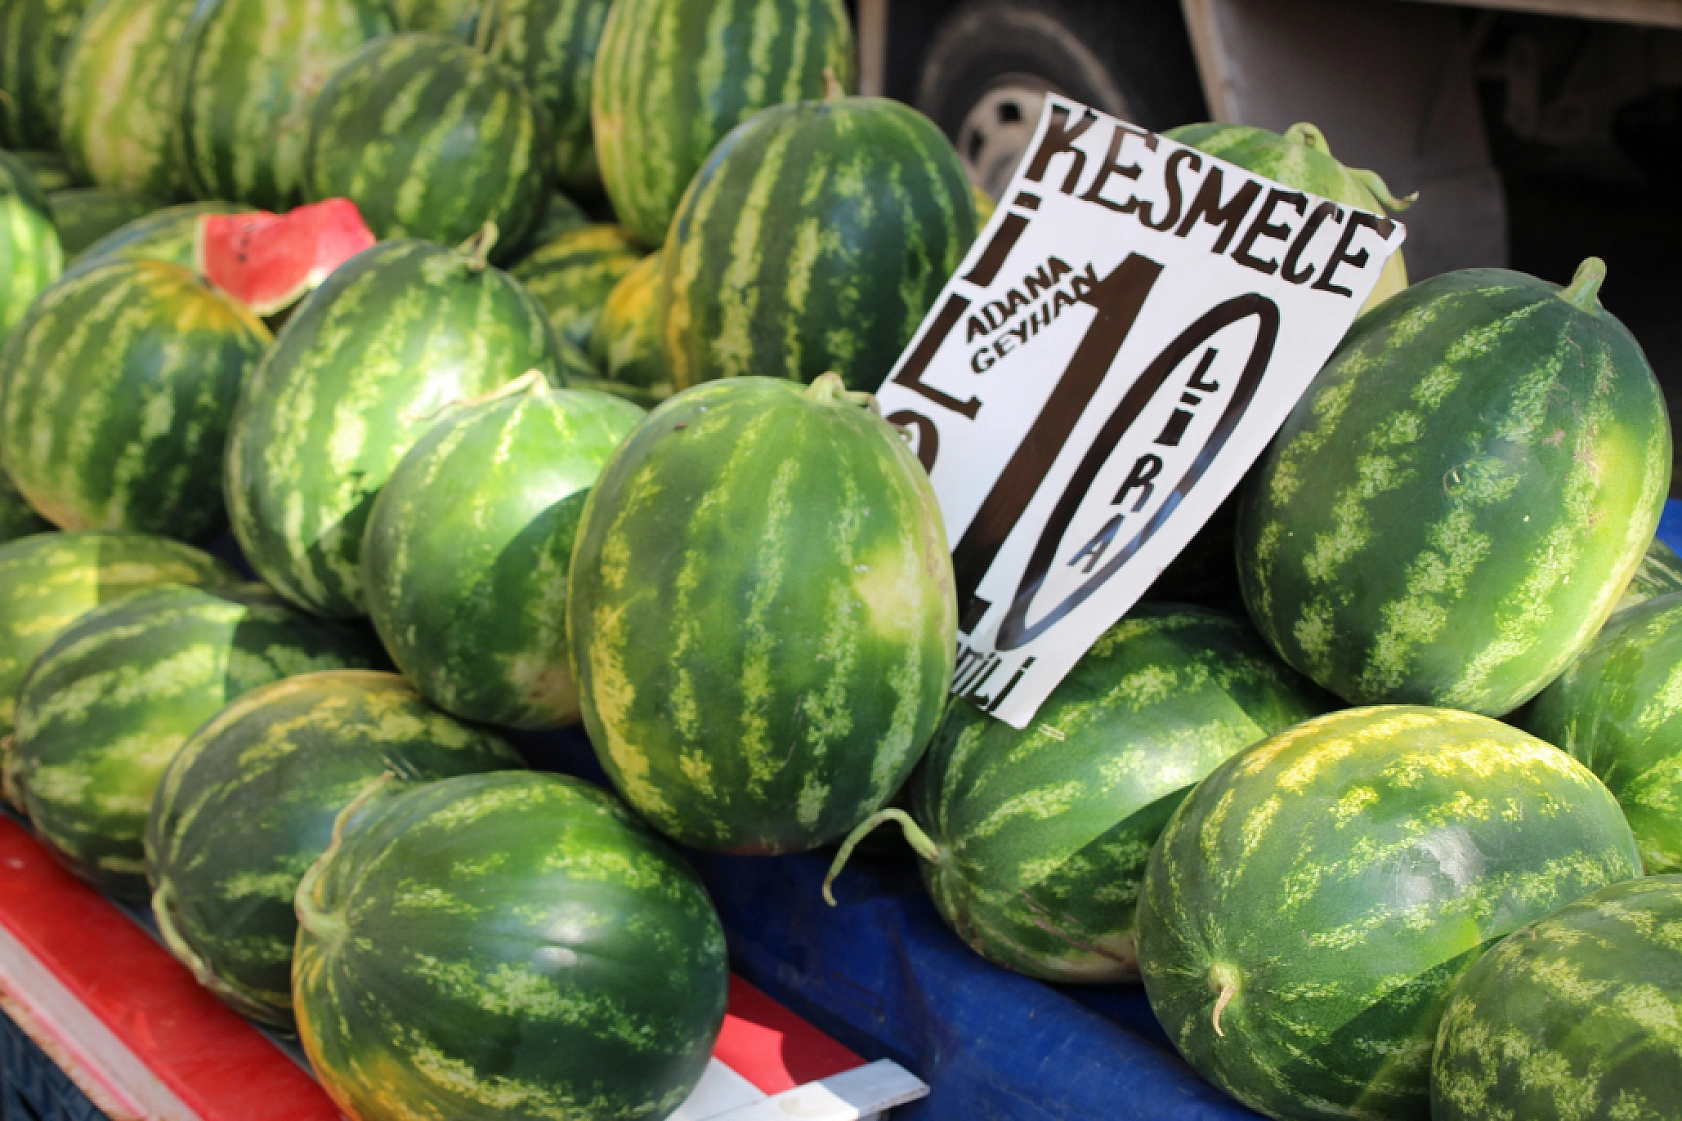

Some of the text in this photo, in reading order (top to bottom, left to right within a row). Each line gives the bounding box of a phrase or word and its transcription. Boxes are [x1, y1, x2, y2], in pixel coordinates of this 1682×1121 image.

[1024, 103, 1395, 298] KESMECE
[965, 254, 1072, 345] ADANA
[957, 251, 1280, 651] 10
